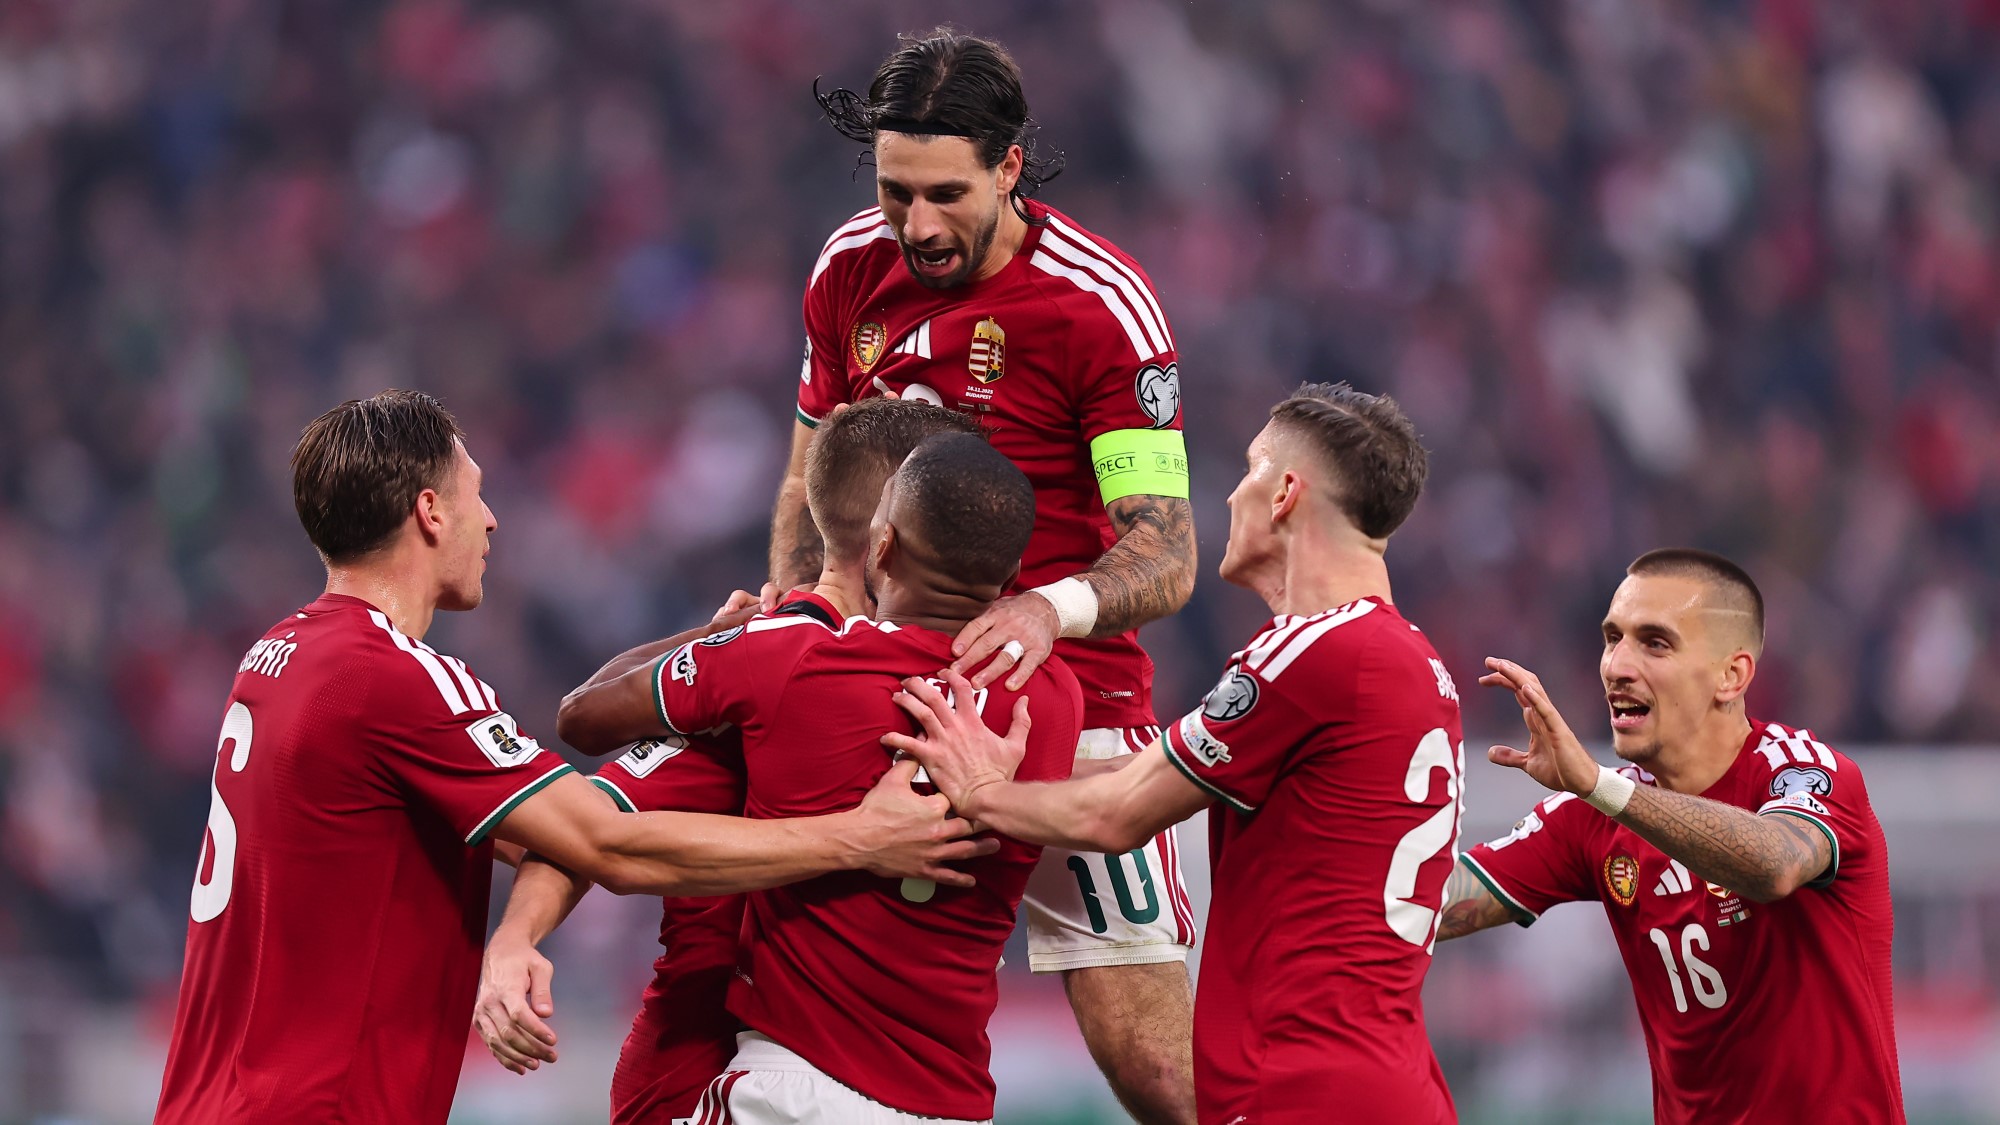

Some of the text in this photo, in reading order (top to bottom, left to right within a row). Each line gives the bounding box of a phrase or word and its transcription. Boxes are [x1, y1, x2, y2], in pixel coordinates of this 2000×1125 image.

[190, 701, 254, 923] 6
[1067, 848, 1160, 934] 10
[1649, 923, 1728, 1014] 16
